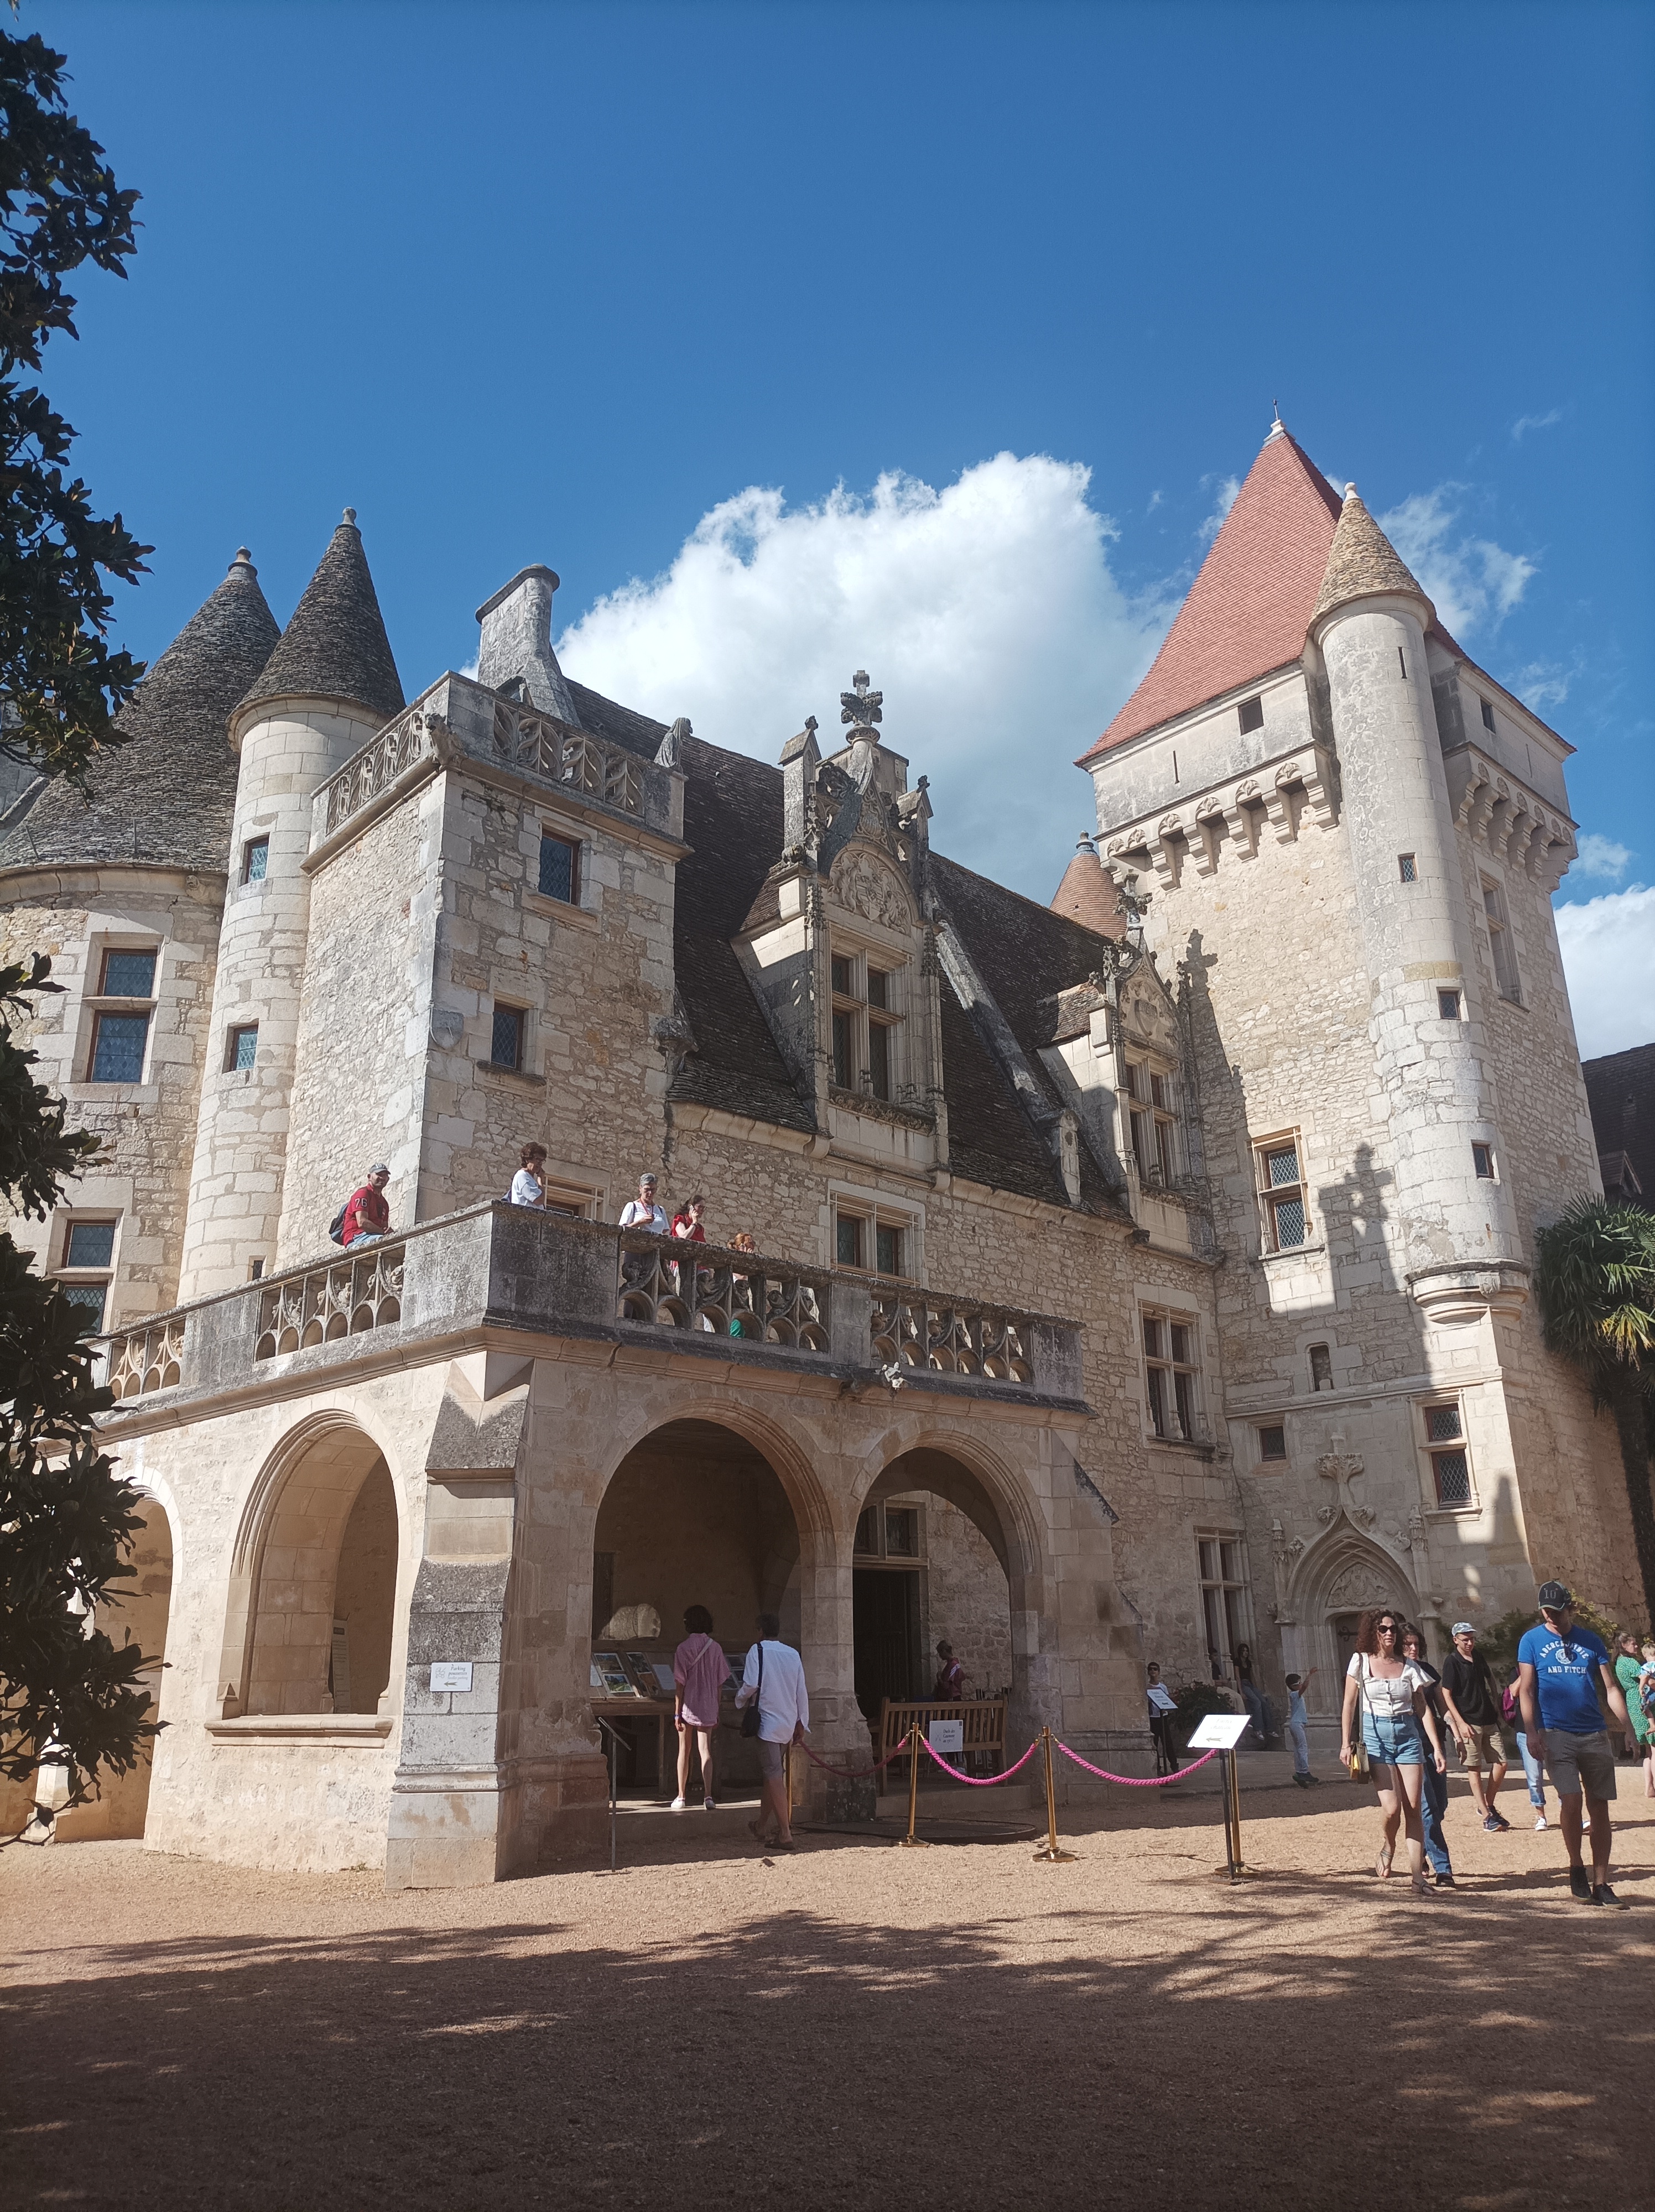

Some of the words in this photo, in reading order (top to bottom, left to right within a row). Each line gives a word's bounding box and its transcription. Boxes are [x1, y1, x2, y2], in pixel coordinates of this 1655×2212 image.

[355, 1198, 367, 1208] 76
[1544, 1590, 1557, 1599] 10
[1548, 1666, 1563, 1674] AND
[1564, 1666, 1586, 1674] FITCH
